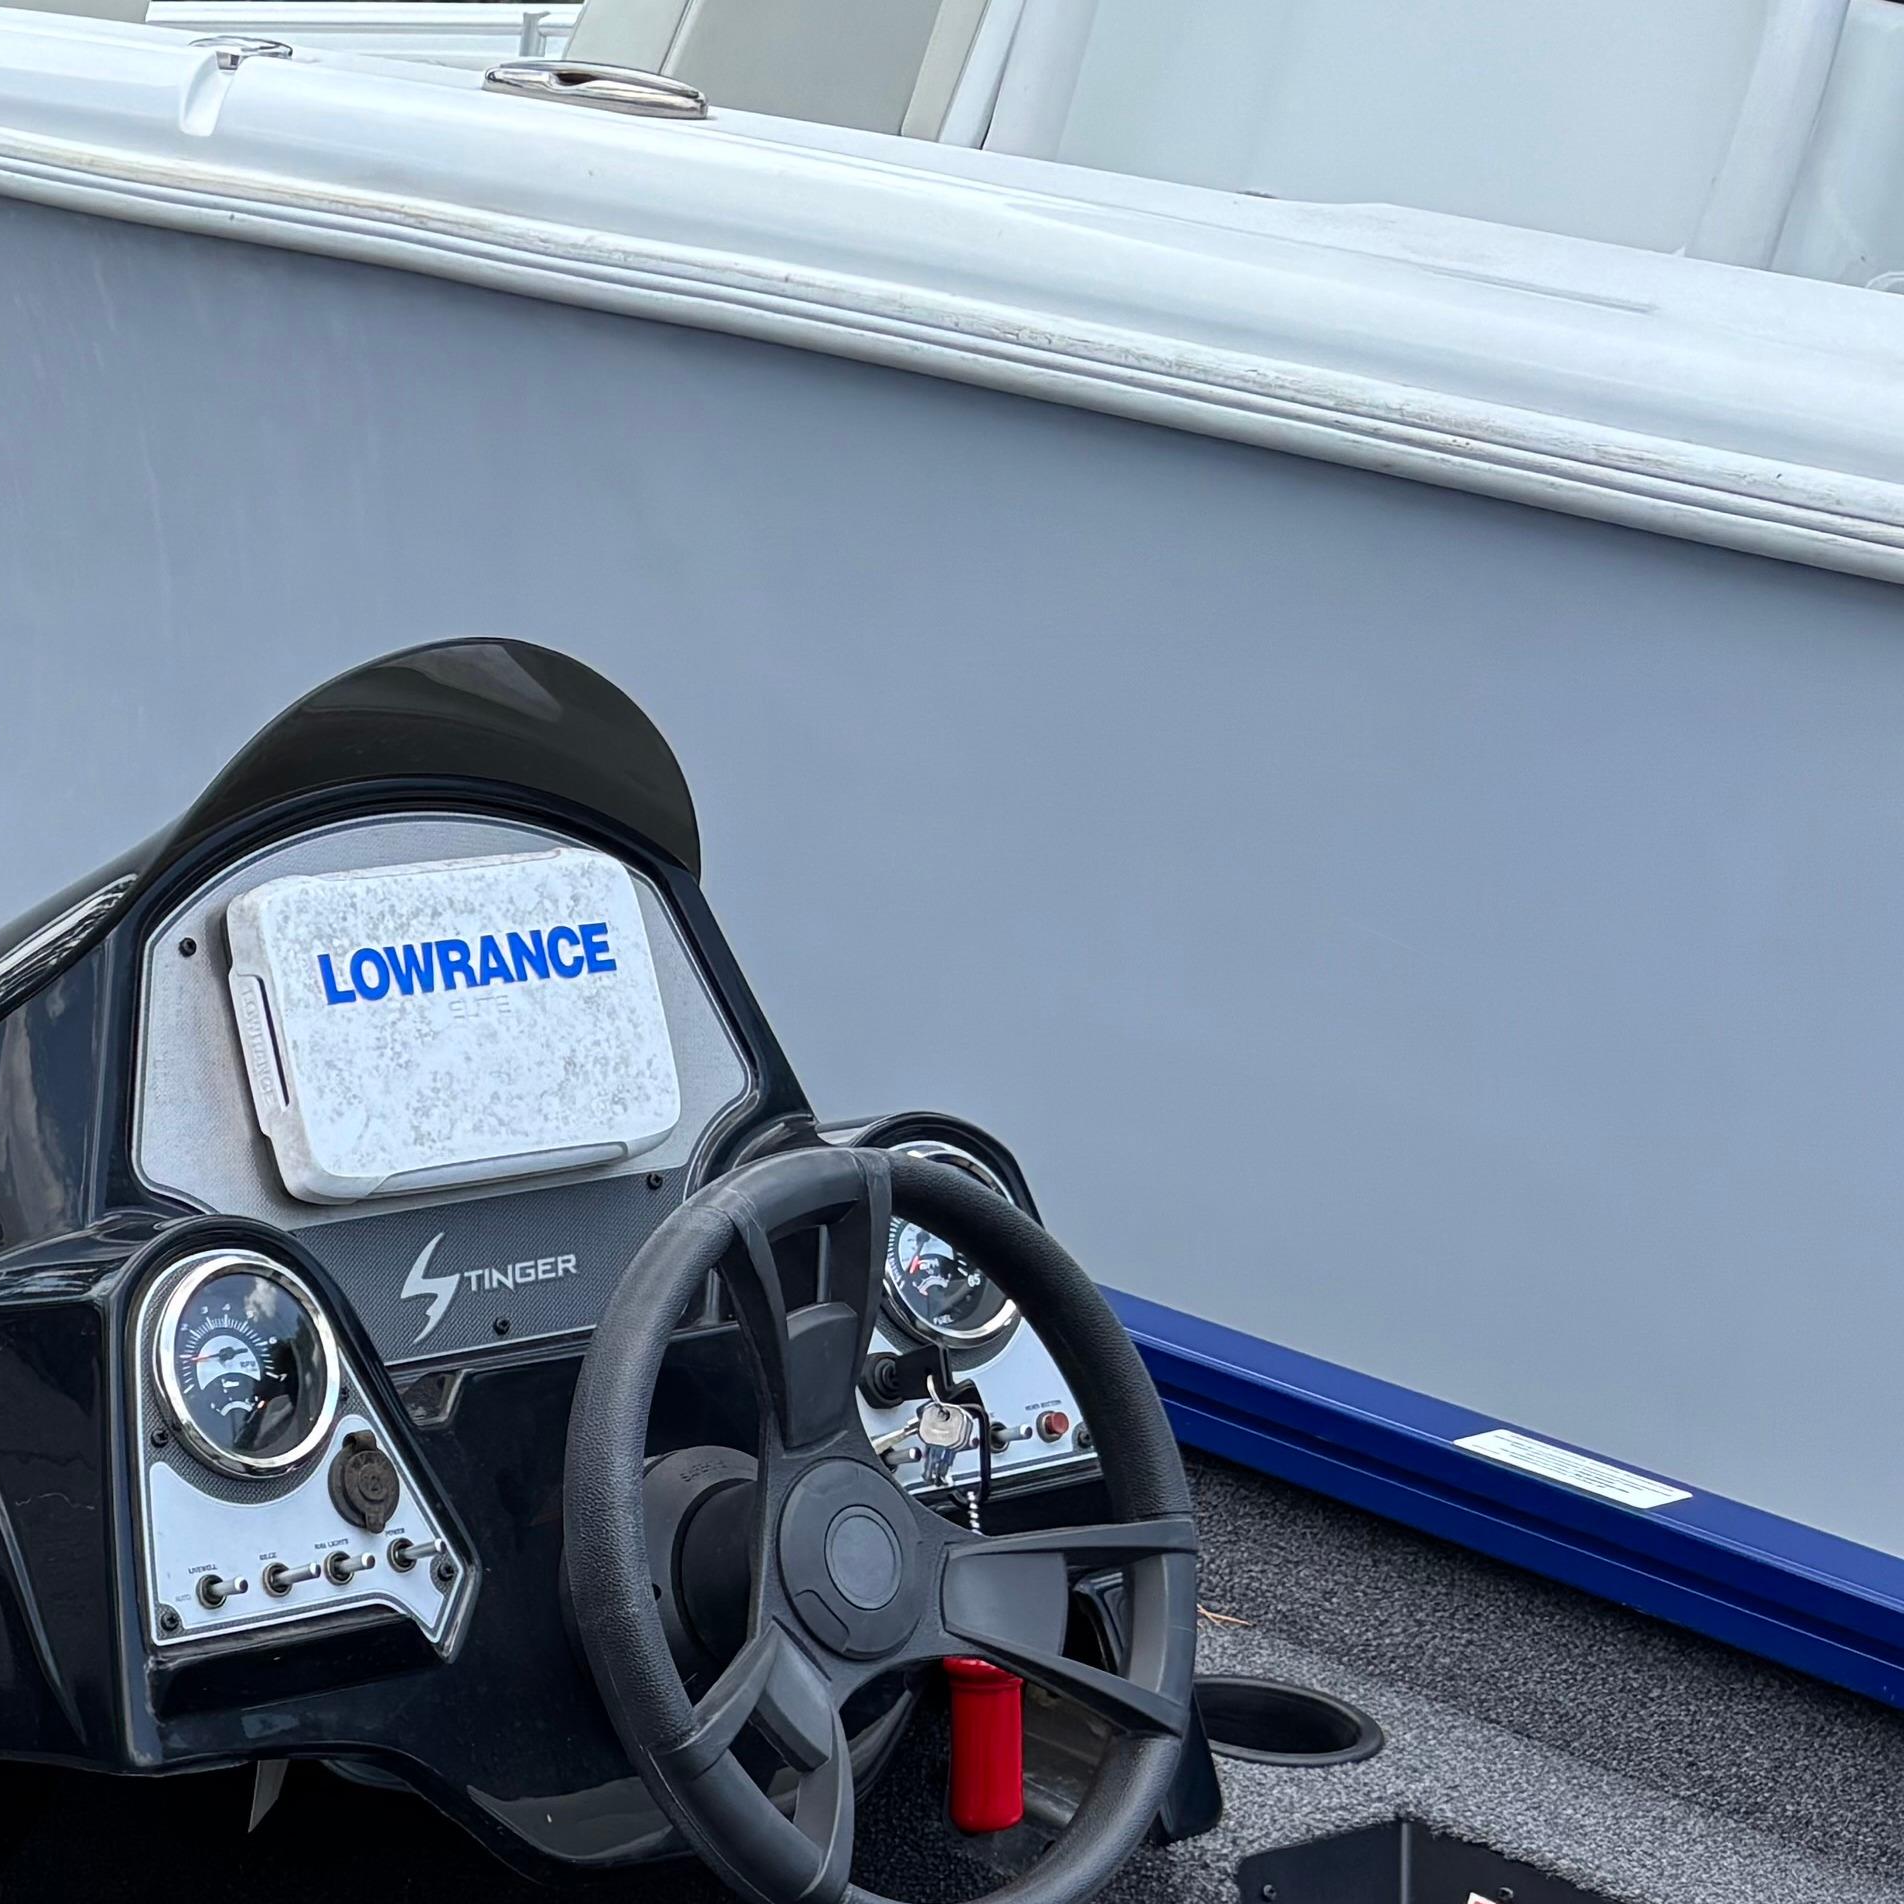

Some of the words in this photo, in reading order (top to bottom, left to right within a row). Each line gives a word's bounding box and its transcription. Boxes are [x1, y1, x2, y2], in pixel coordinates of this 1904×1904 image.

[317, 922, 617, 1005] LOWRANCE
[968, 1273, 980, 1287] 65
[933, 1314, 954, 1325] FUEL
[268, 1336, 277, 1344] 6
